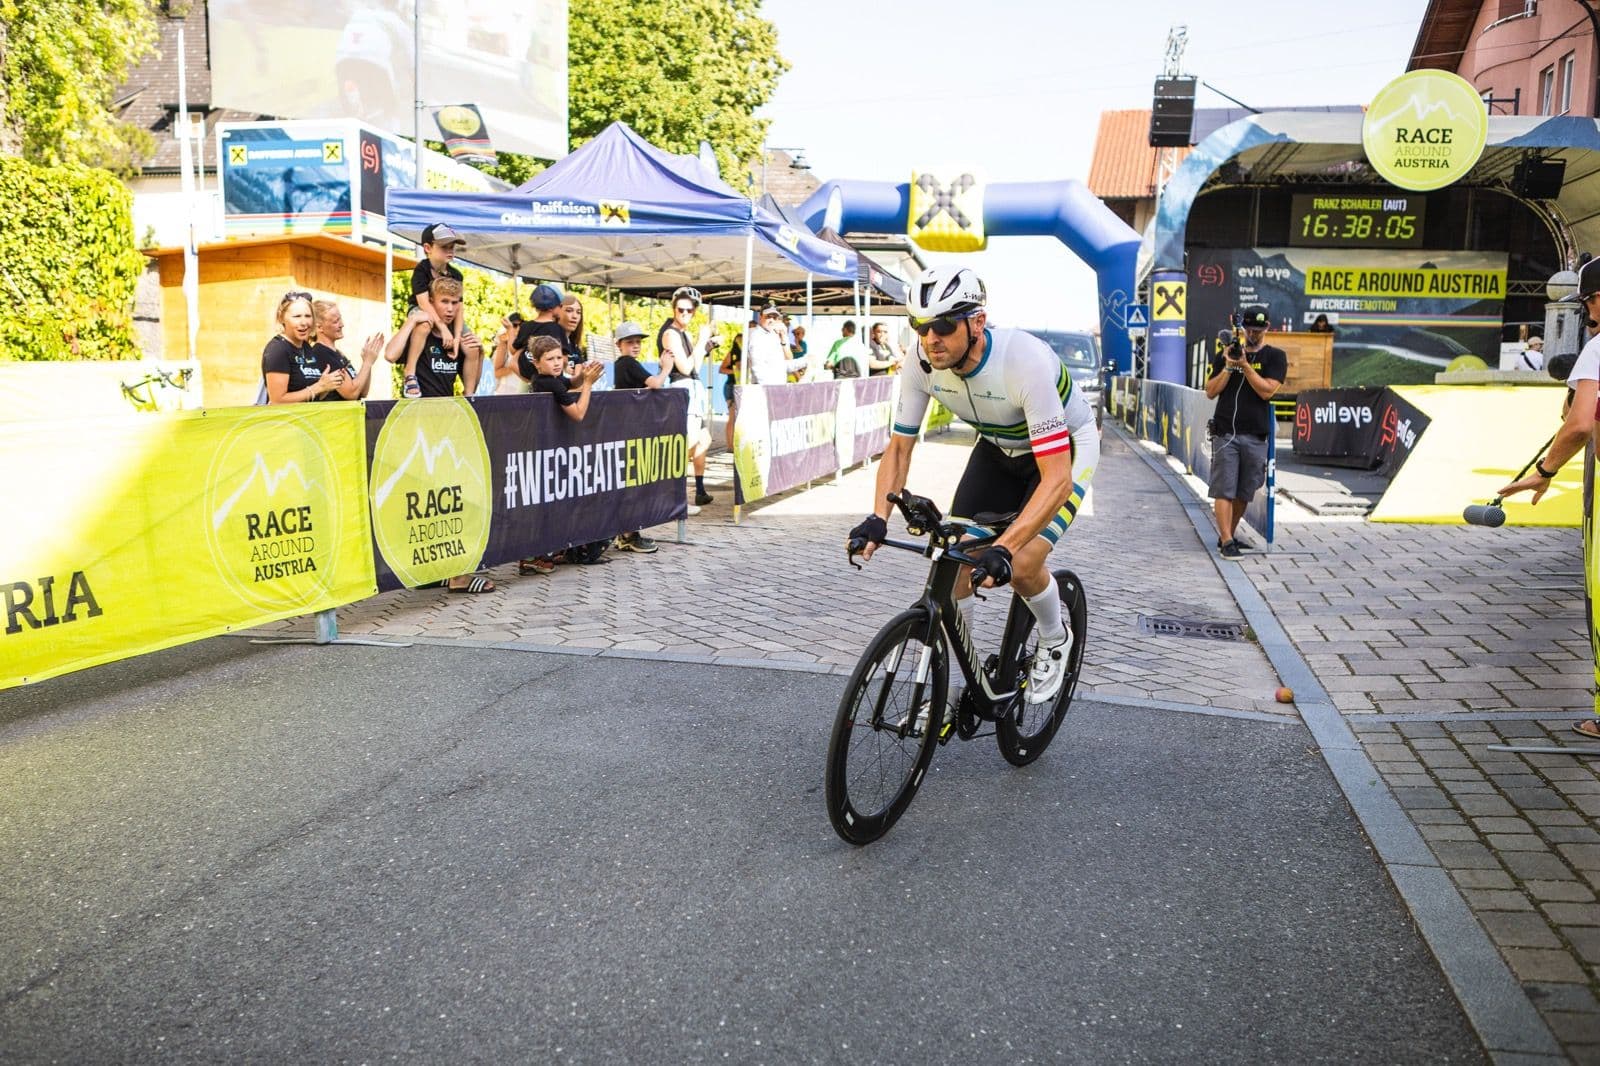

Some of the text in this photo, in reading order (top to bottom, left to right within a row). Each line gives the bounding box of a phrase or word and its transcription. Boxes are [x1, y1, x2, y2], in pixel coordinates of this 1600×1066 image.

[1395, 128, 1453, 144] RACE
[1394, 145, 1452, 157] AROUND
[1394, 158, 1450, 169] AUSTRIA
[532, 201, 595, 214] Raiffeisen
[1313, 198, 1340, 210] FRANZ
[1302, 214, 1416, 239] 16:38:05
[1238, 265, 1263, 278] evil
[1311, 271, 1500, 294] RACE AROUND AUSTRIA
[1314, 402, 1337, 424] evil
[405, 485, 463, 520] RACE
[245, 506, 313, 541] RACE
[408, 517, 464, 544] AROUND
[250, 536, 315, 562] AROUND
[412, 538, 466, 565] AUSTRIA
[254, 556, 317, 582] AUSTRIA
